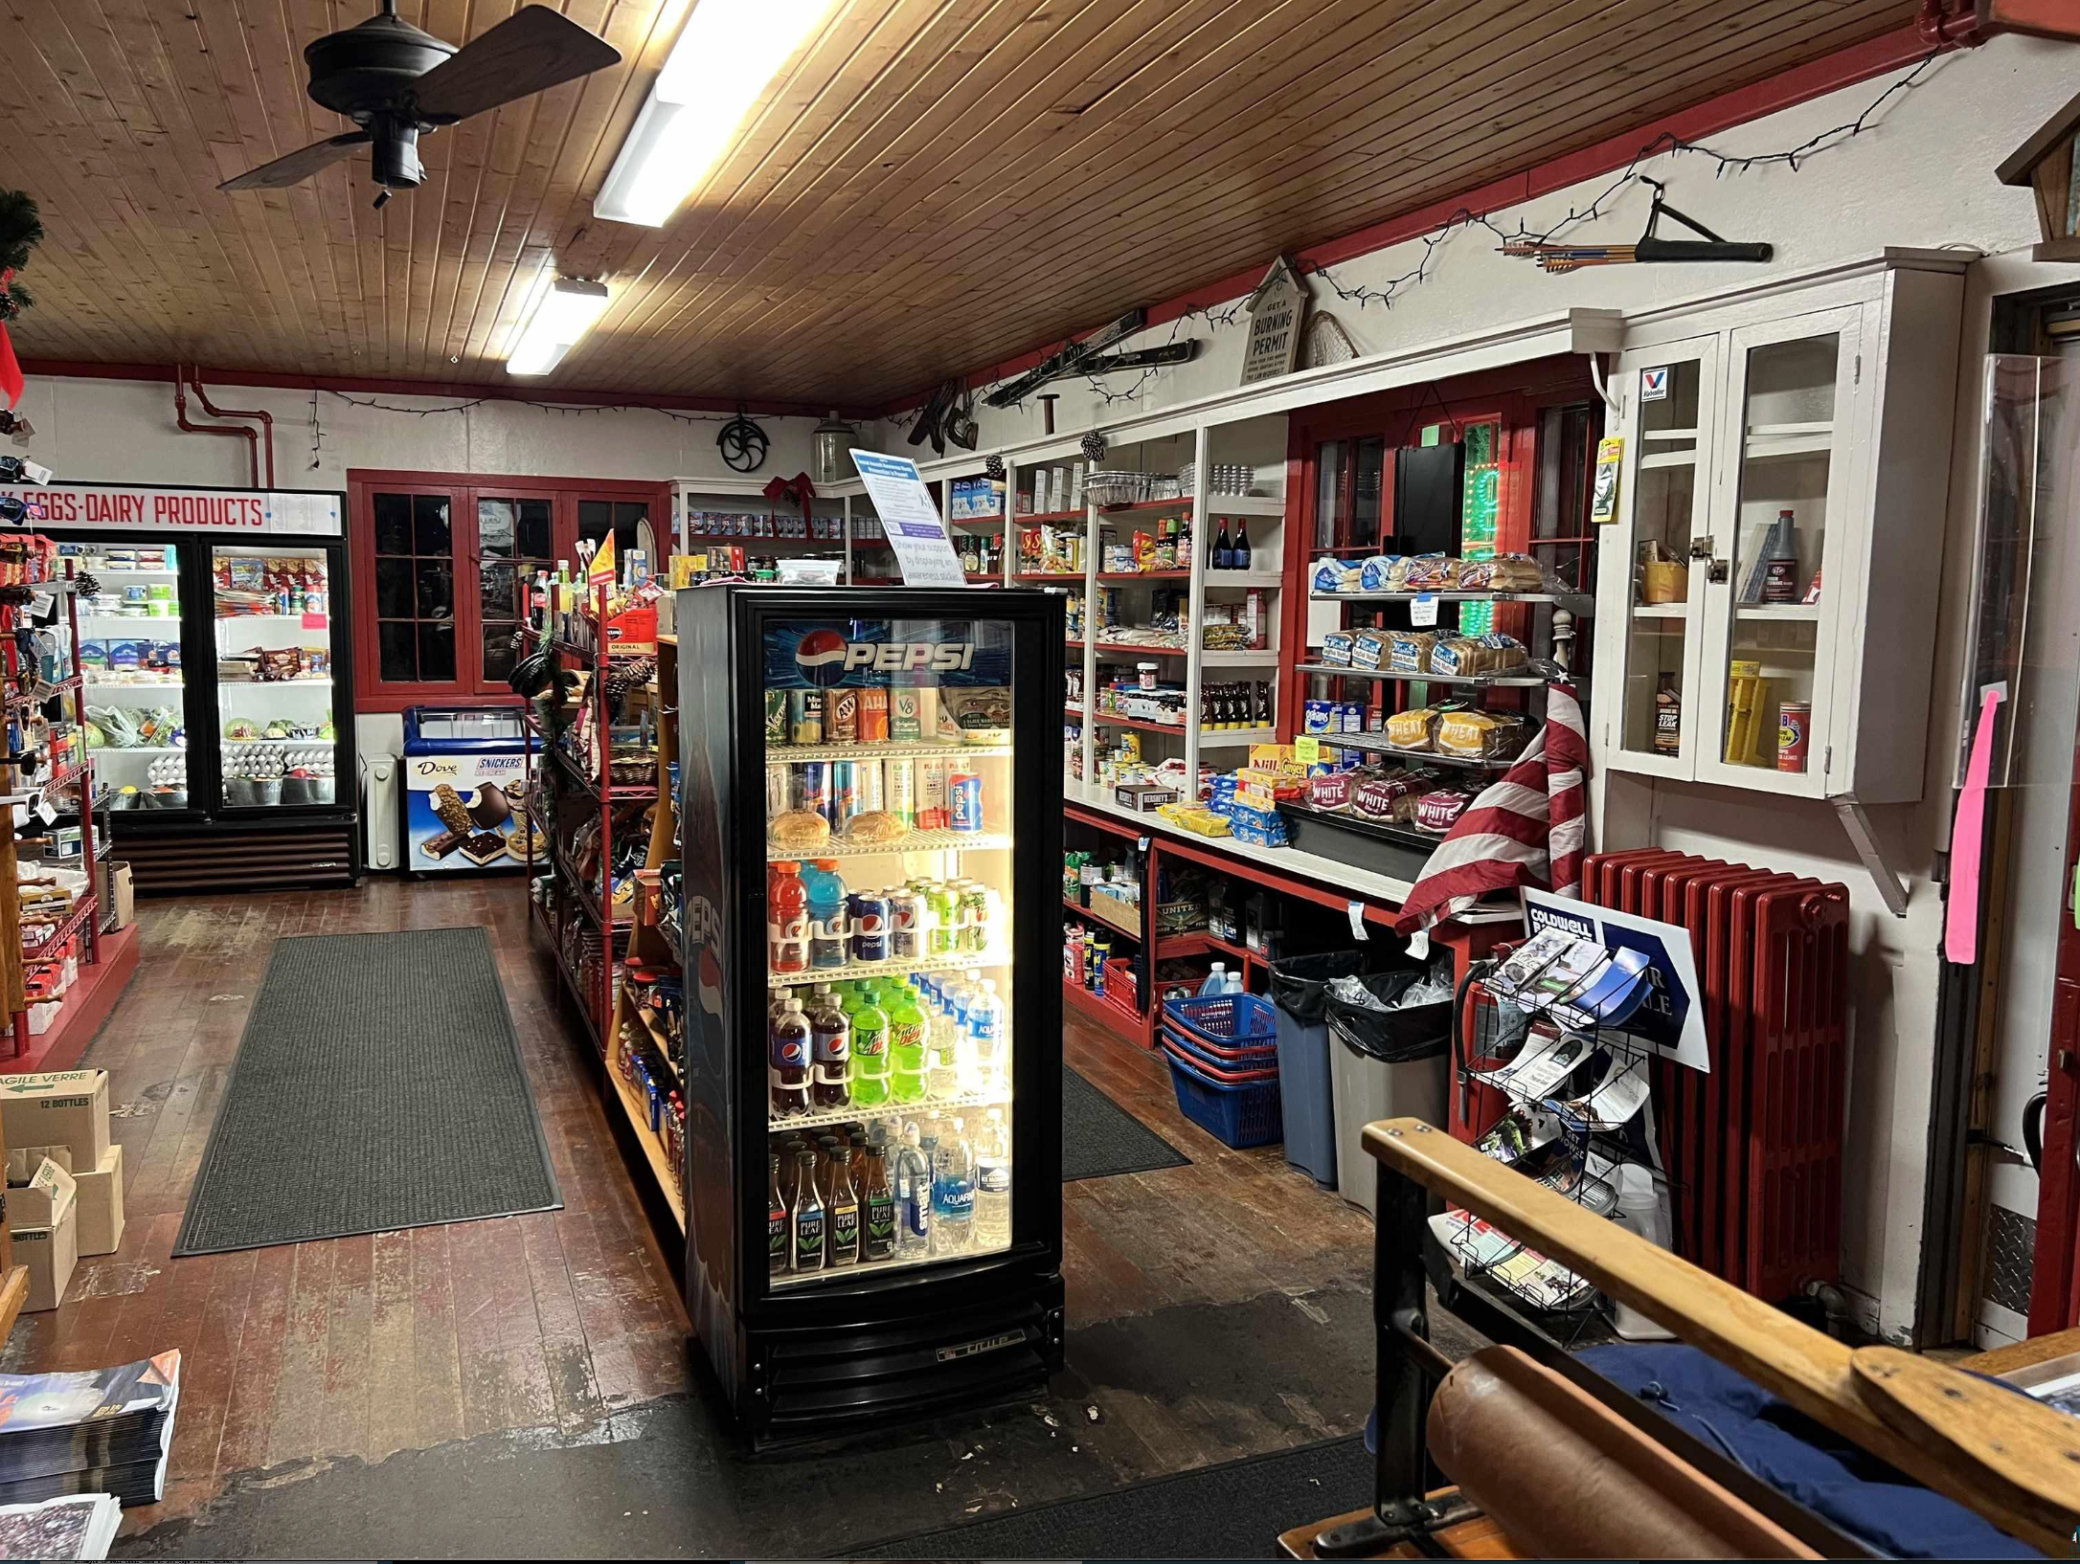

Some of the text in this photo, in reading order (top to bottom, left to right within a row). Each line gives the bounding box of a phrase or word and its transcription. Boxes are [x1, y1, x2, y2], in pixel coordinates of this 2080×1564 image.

[1254, 309, 1293, 337] BURNING
[1253, 331, 1289, 357] PERMIT
[154, 496, 262, 526] PRODUCTS
[844, 643, 975, 671] PEPSI
[899, 698, 914, 714] V8
[1658, 720, 1677, 728] LEAK
[480, 758, 521, 768] SNICKERS
[1313, 786, 1344, 799] WHITE
[954, 785, 966, 820] pepsi
[1358, 790, 1389, 811] WHITE
[1418, 803, 1455, 821] WHITE
[862, 940, 882, 948] pepsi
[42, 1072, 88, 1083] VERRE
[40, 1097, 89, 1109] 12 BOTTLES
[1566, 1130, 1580, 1144] GET
[872, 1205, 891, 1214] PURE
[917, 1182, 930, 1231] smart
[837, 1213, 856, 1222] PURE
[872, 1211, 891, 1220] LEAF
[769, 1220, 783, 1228] URE
[800, 1220, 820, 1229] PURE
[837, 1219, 856, 1228] LEAF
[769, 1226, 783, 1235] EAF
[800, 1226, 820, 1236] LEAF
[12, 1231, 48, 1243] BOTTLES
